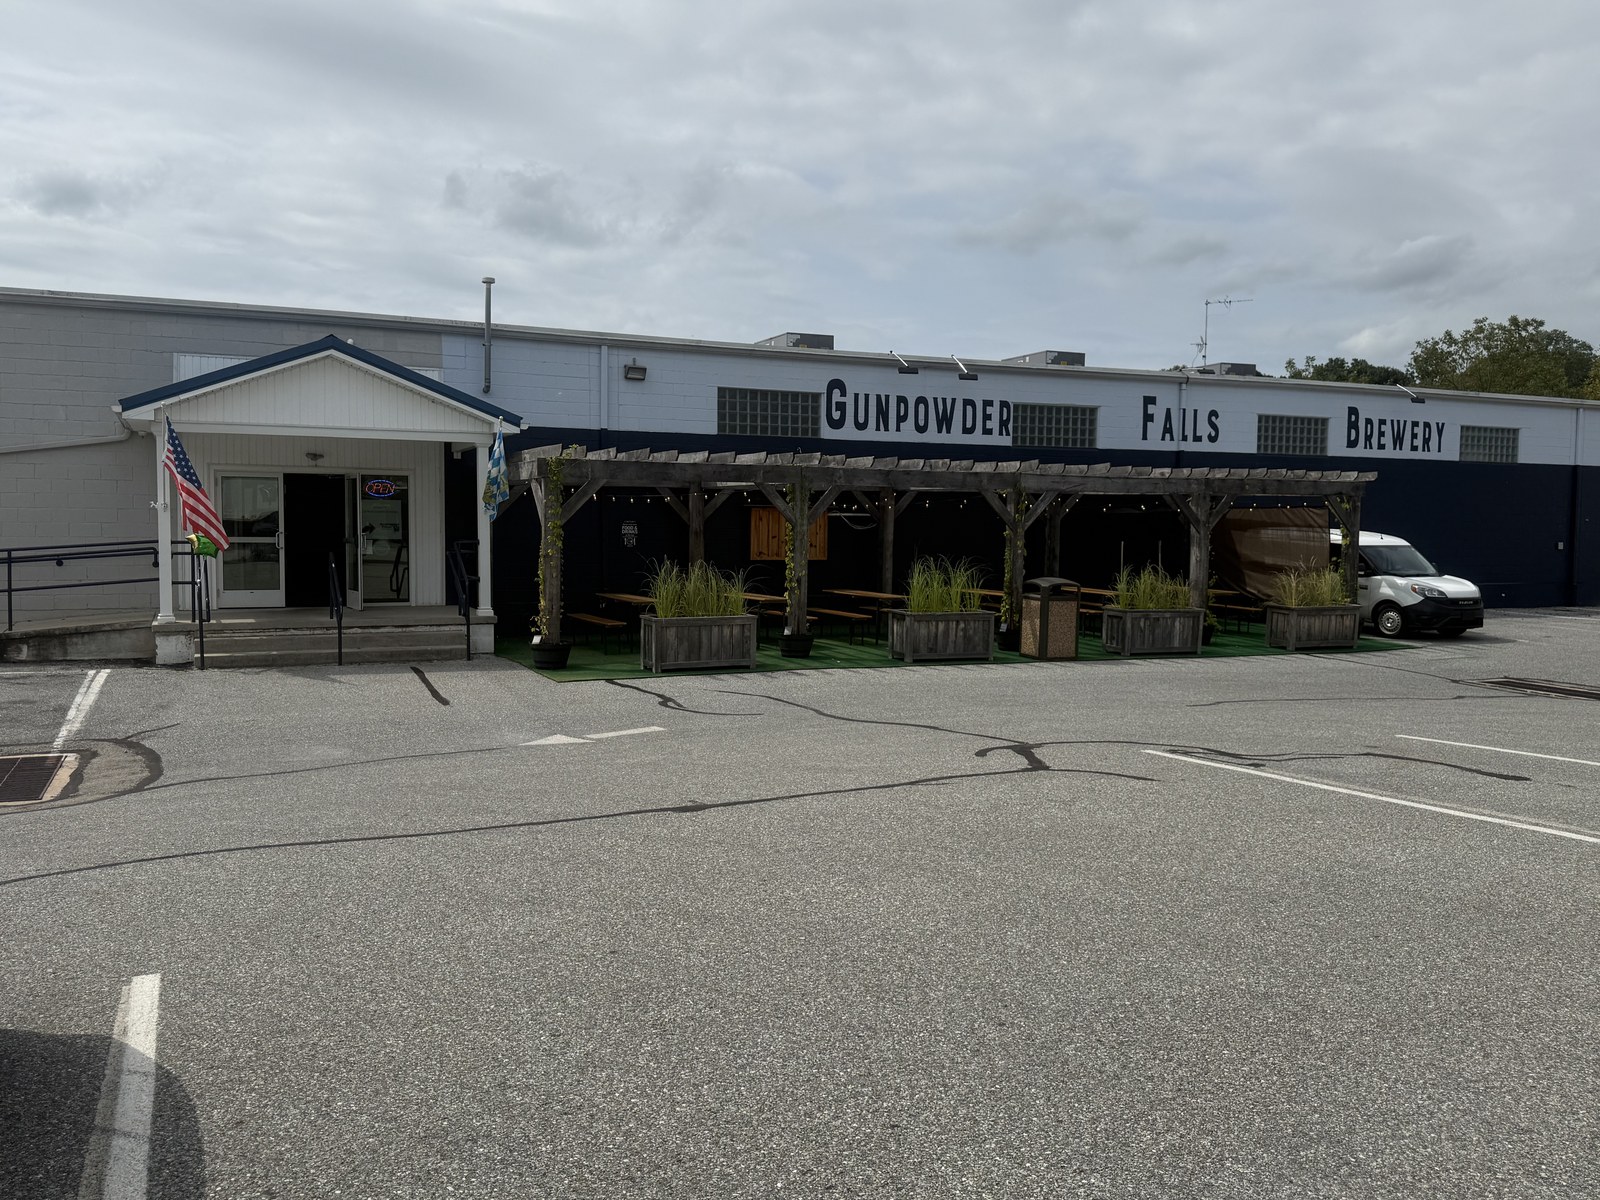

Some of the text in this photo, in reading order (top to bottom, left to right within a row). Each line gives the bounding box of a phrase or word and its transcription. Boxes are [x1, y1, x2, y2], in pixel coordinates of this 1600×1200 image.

[825, 378, 1446, 453] GUNPOWDER FALLS BREWERY
[365, 483, 396, 493] OPEN
